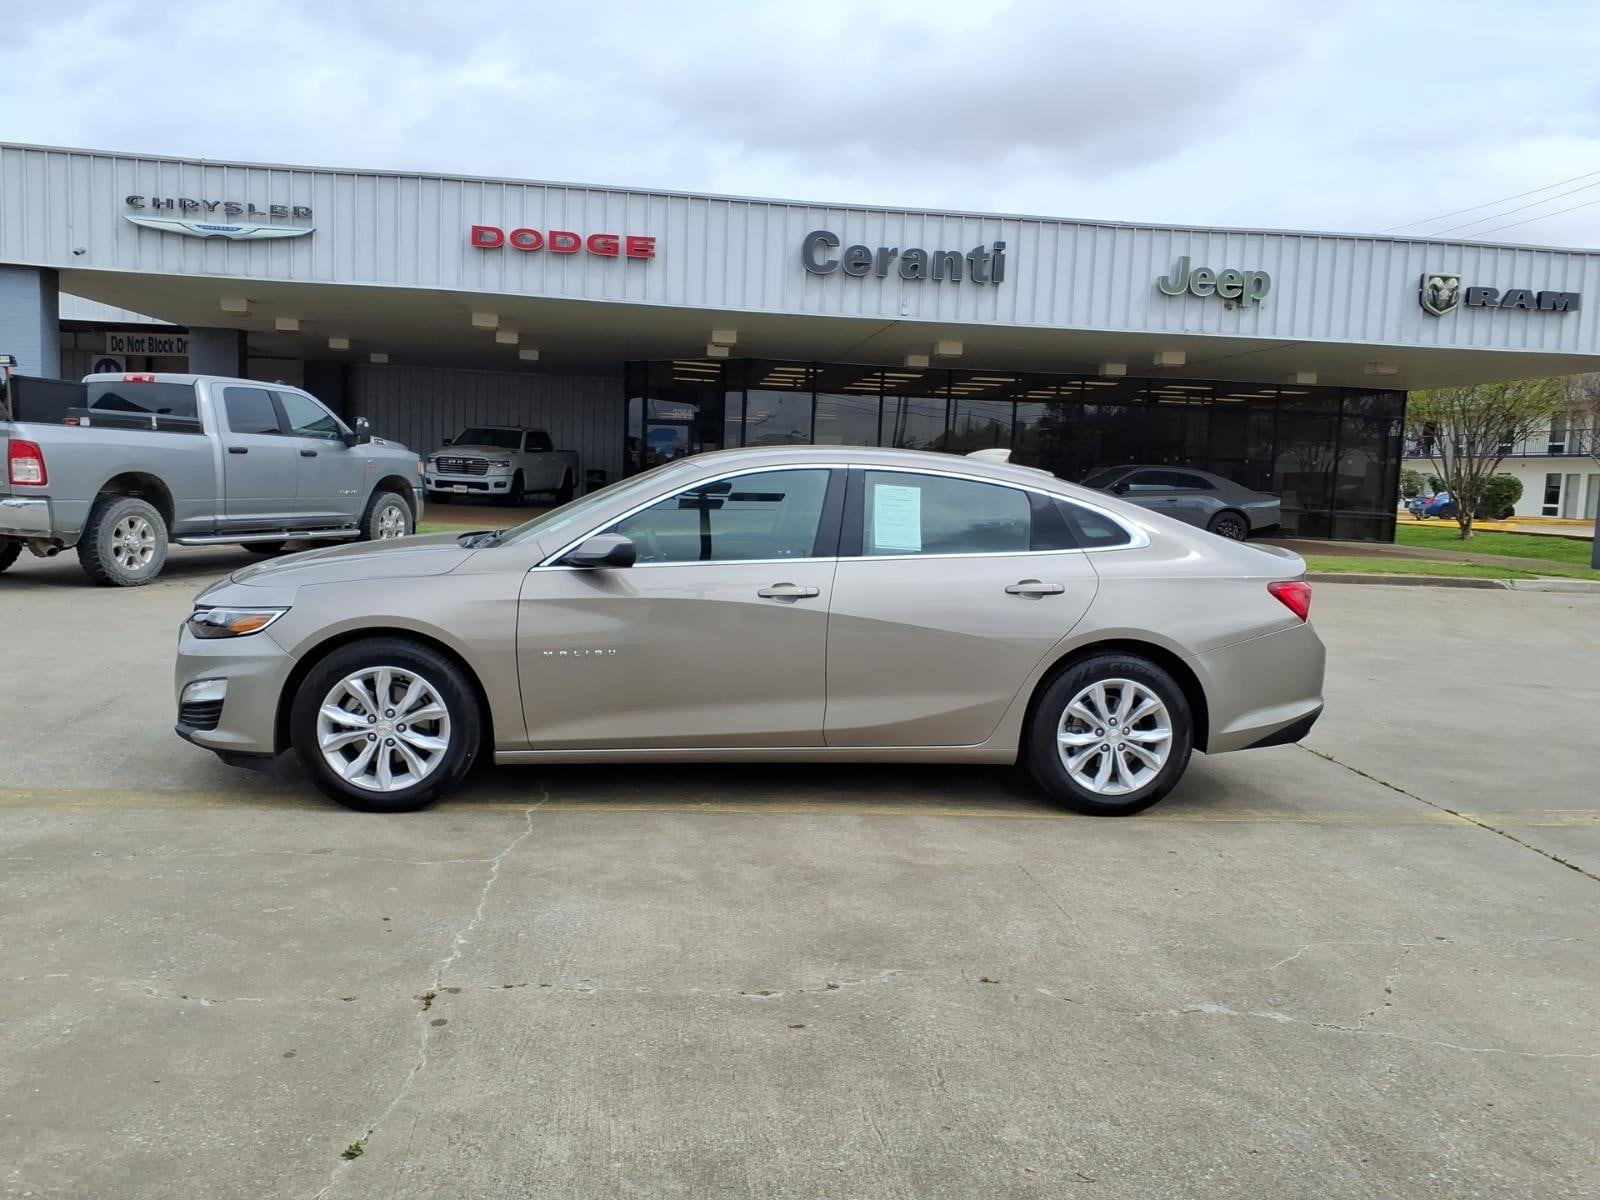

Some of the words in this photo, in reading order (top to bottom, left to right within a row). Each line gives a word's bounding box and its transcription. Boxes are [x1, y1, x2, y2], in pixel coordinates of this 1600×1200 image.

[126, 194, 312, 219] CHRYSLER
[471, 225, 656, 261] DODGE
[801, 230, 1006, 284] Ceranti
[1157, 256, 1271, 308] Jeep
[1464, 286, 1580, 311] RAM
[111, 336, 124, 352] Do
[127, 336, 145, 353] Not
[148, 337, 174, 353] Block
